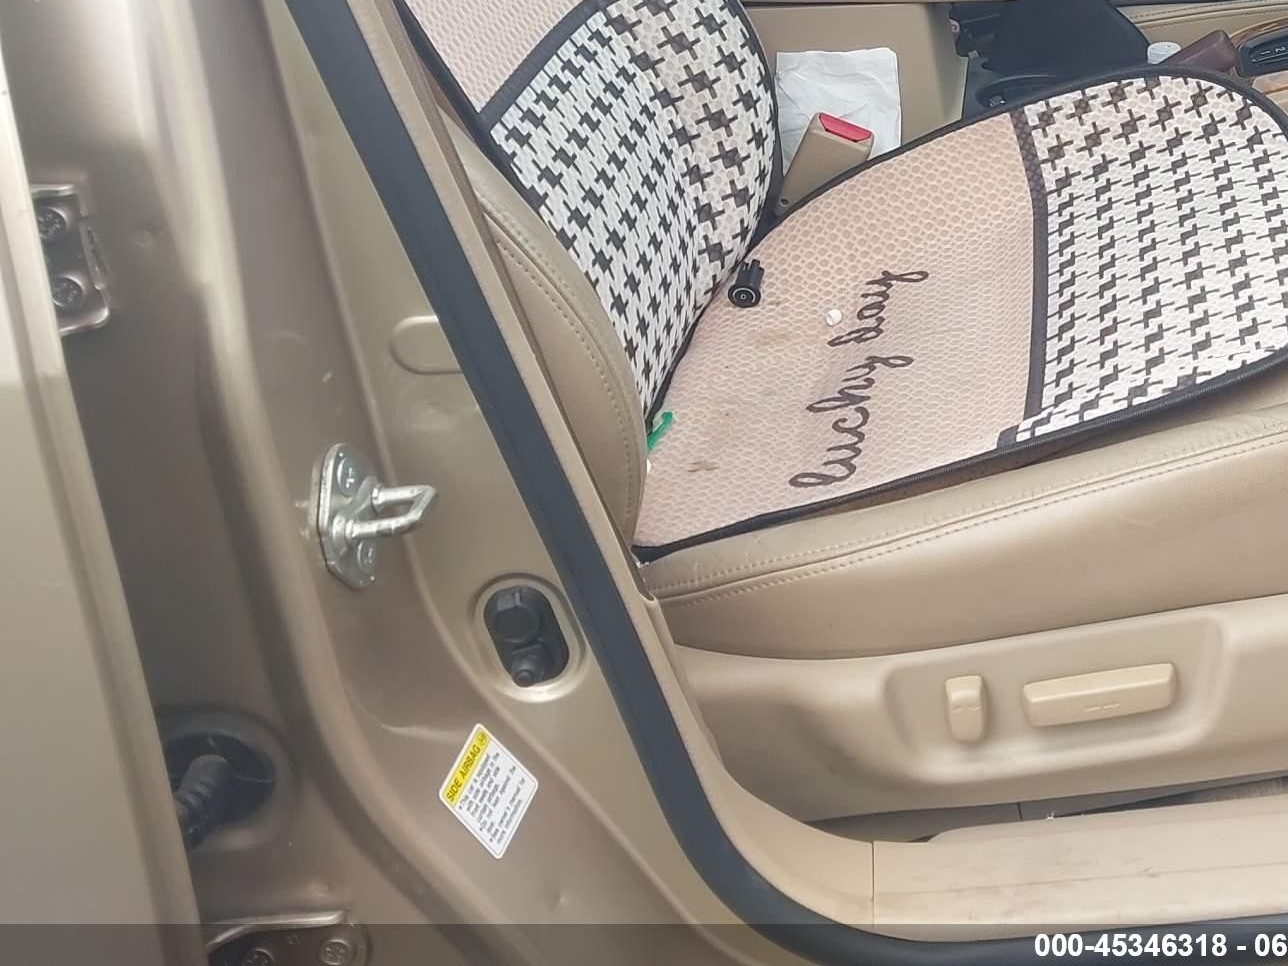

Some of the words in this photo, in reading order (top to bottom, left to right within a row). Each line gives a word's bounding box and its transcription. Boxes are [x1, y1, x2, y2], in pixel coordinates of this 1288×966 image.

[827, 269, 929, 347] day
[446, 778, 463, 803] SIDE
[459, 743, 482, 780] AIRBAG
